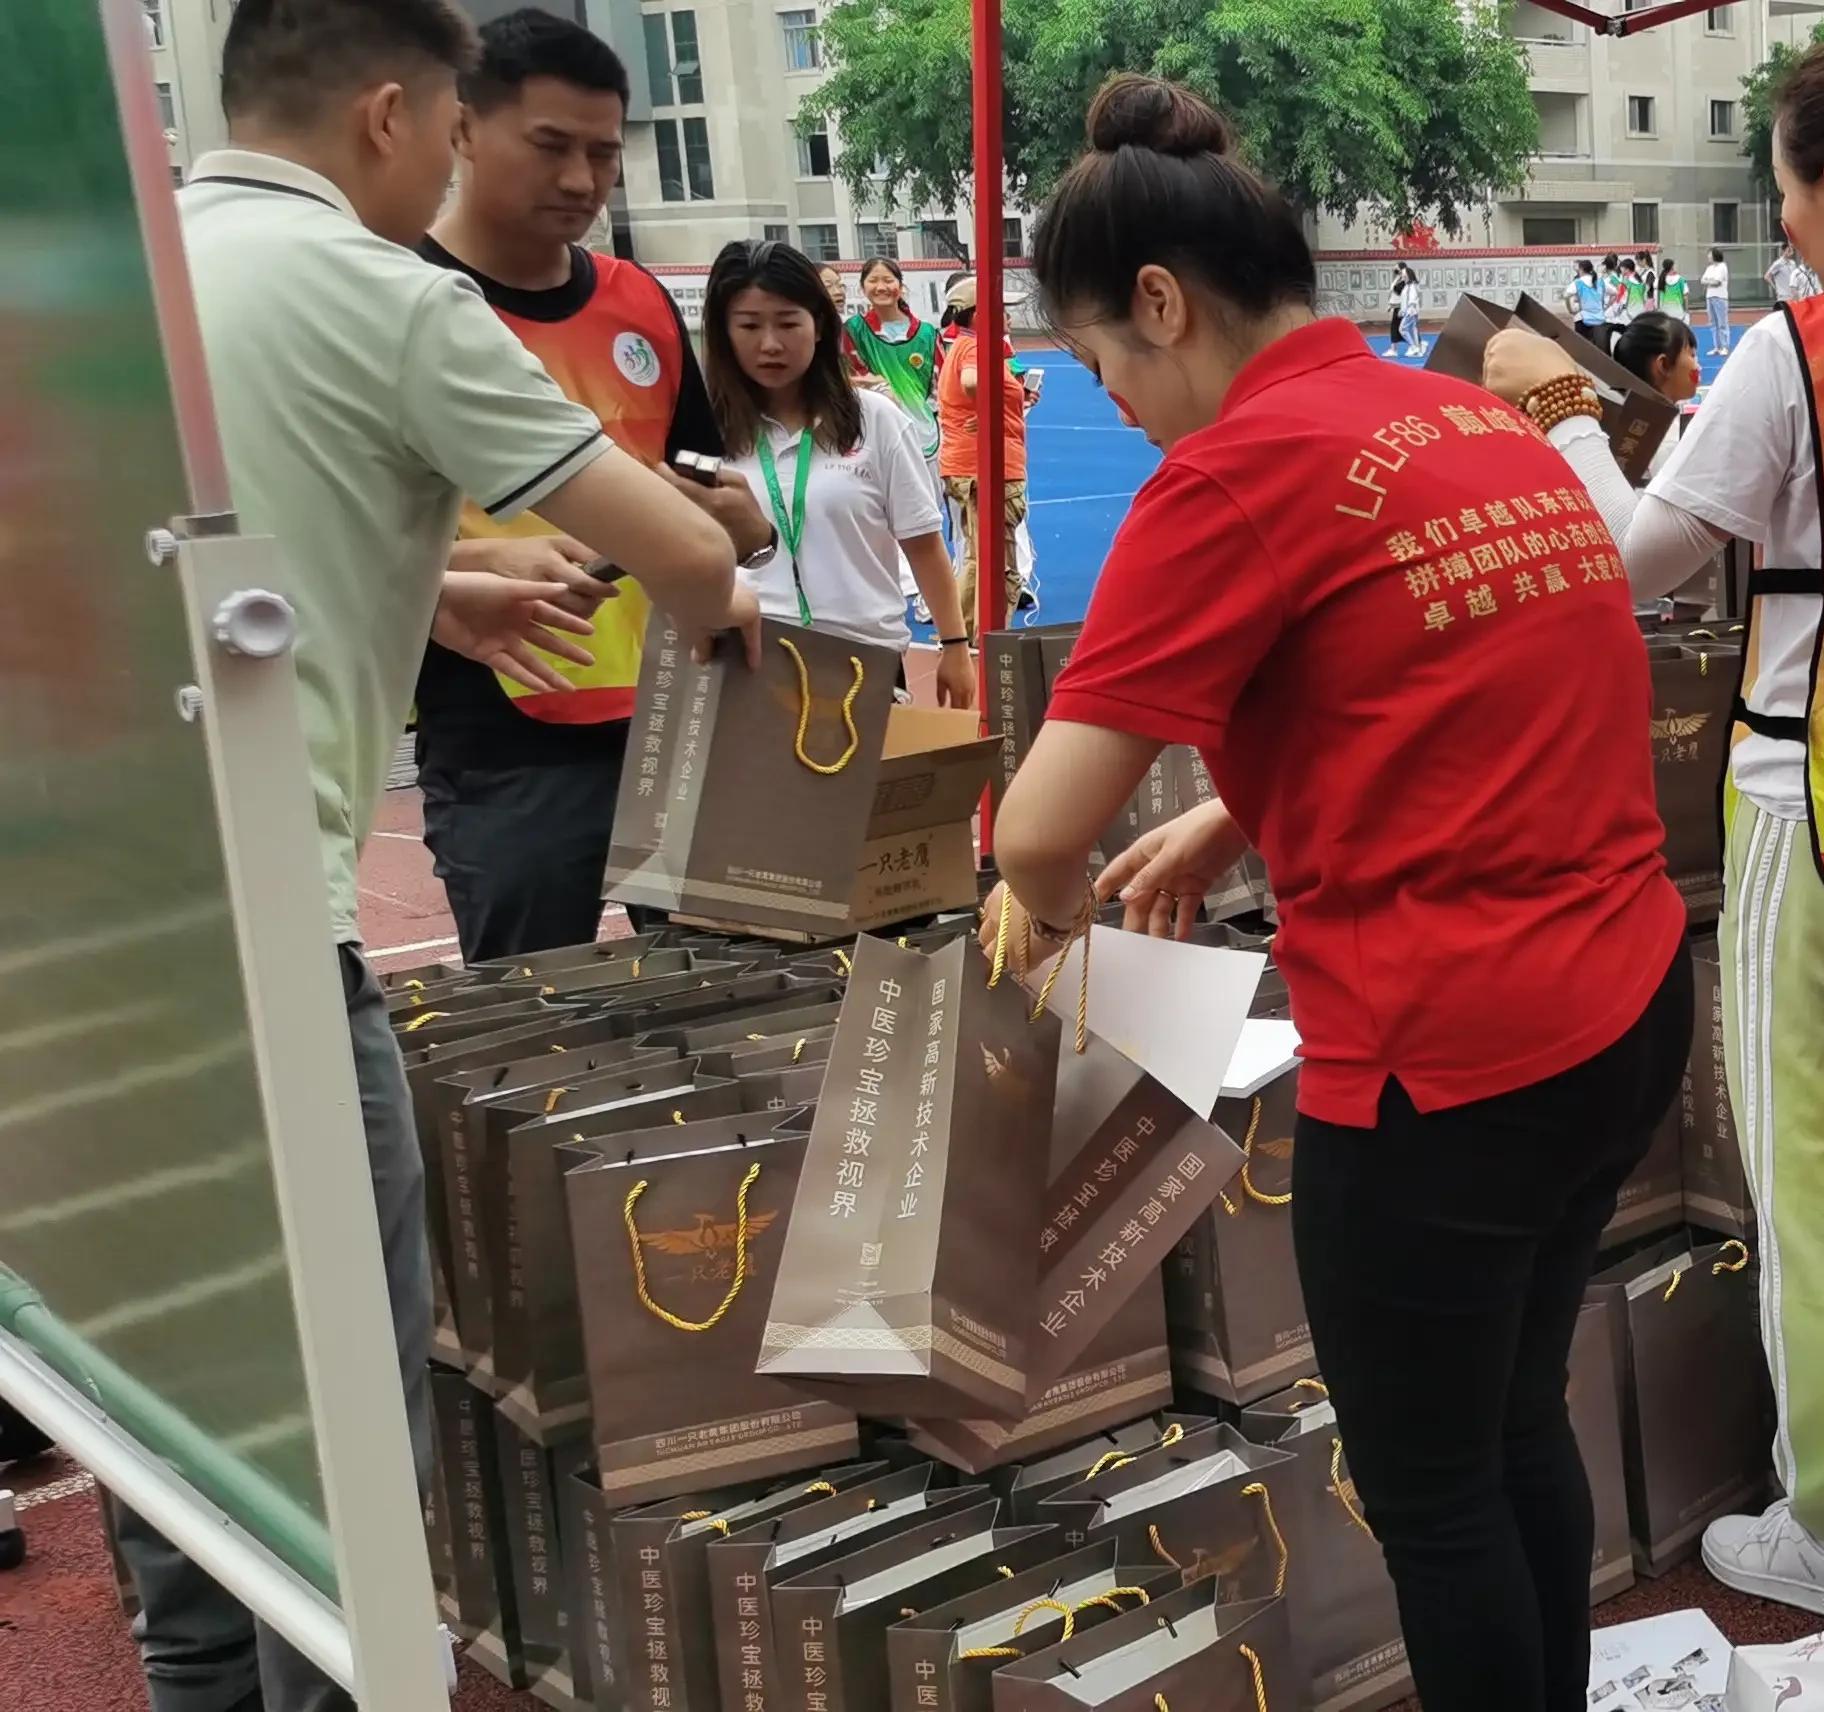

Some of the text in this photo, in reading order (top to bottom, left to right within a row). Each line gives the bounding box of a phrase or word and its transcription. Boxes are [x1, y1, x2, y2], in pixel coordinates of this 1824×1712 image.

[1423, 582, 1498, 633] 卓越
[829, 978, 902, 1219] 中医珍宝拯救视界
[896, 978, 947, 1220] 国家高新技术企业
[1040, 1151, 1206, 1337] 国家高新技术企业
[639, 1545, 672, 1712] 中医珍宝拯救视
